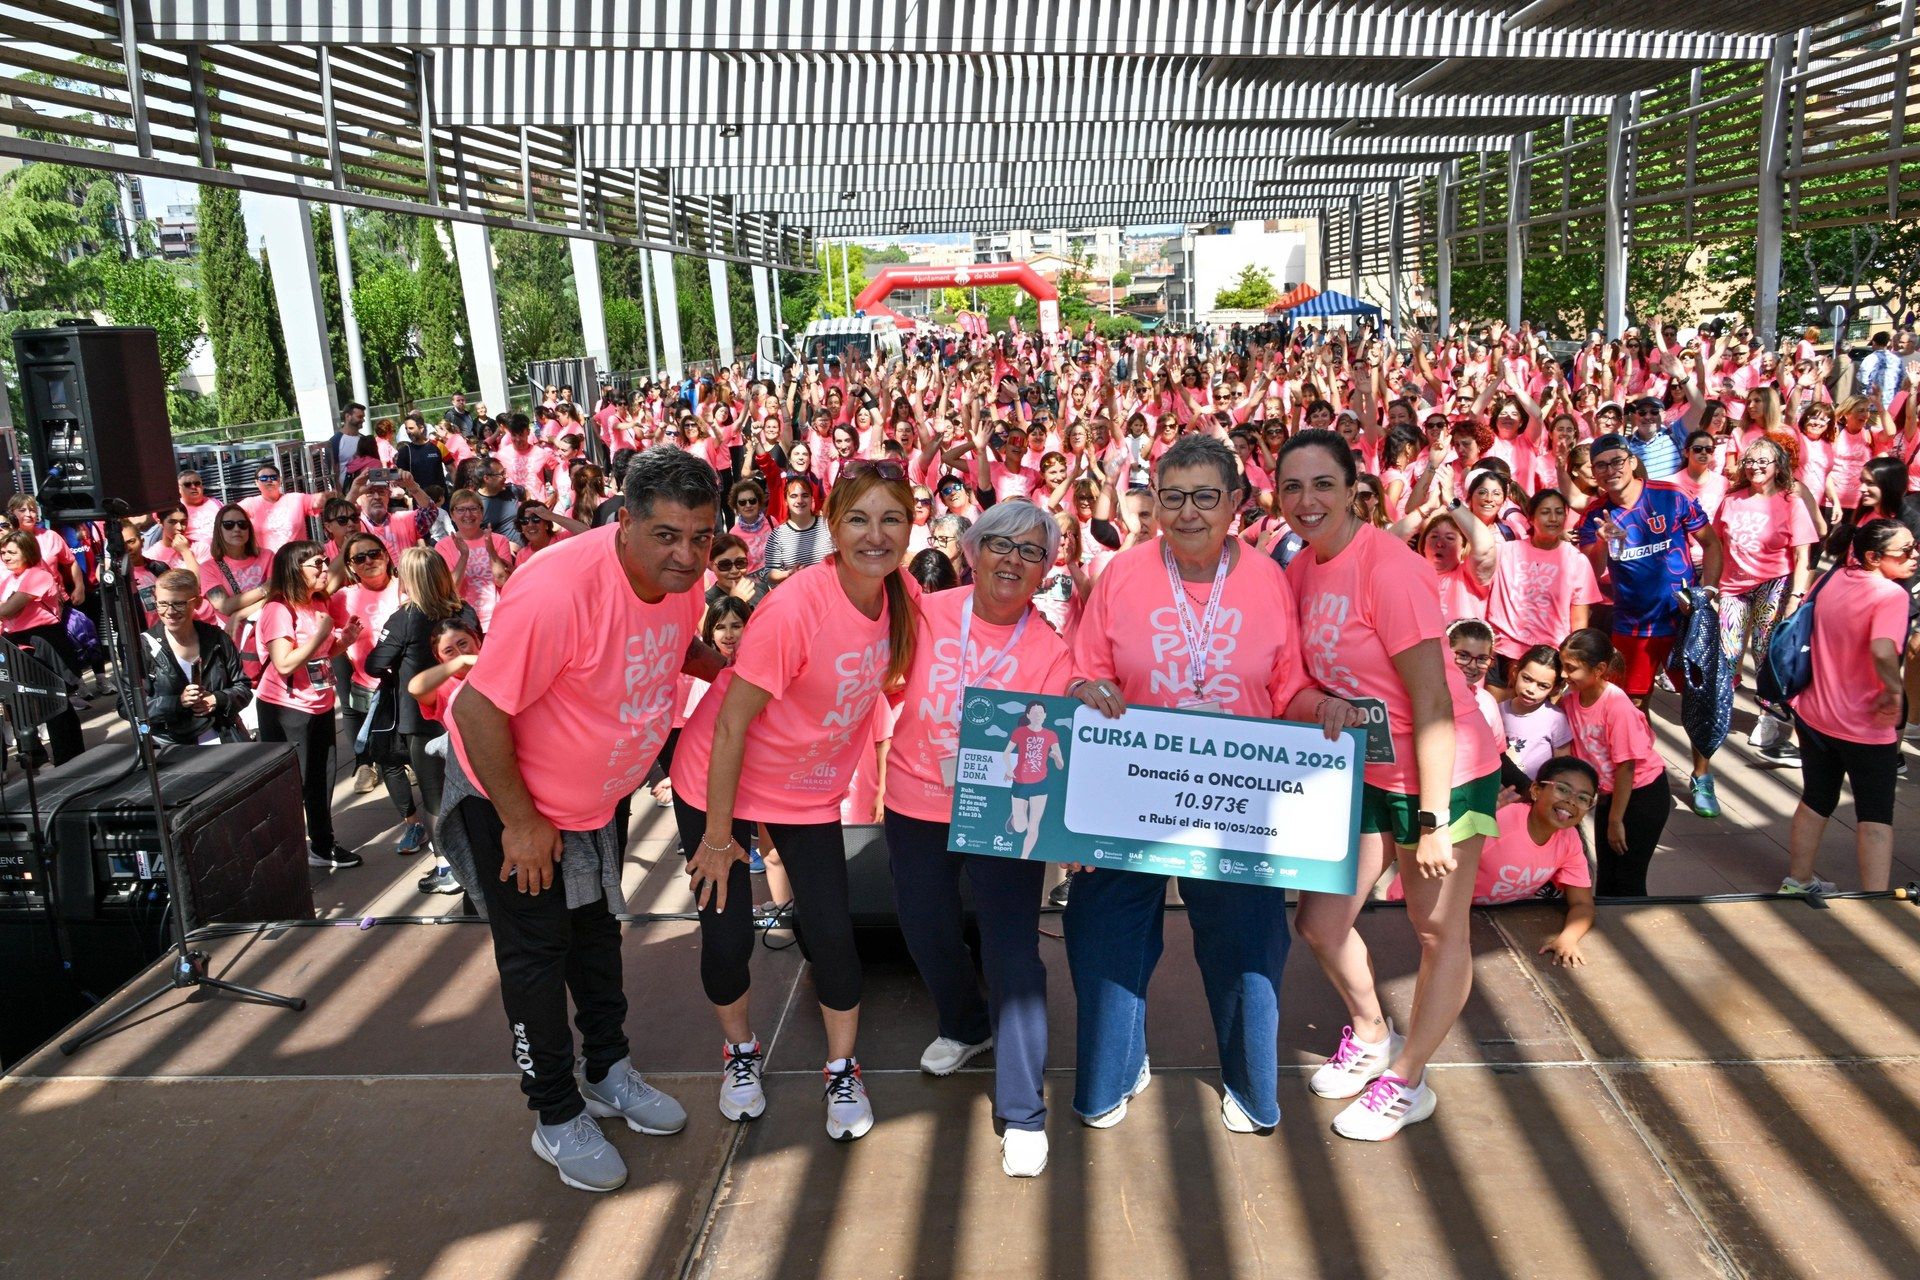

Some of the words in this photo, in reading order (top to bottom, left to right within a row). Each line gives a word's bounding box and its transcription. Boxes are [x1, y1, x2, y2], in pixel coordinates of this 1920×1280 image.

[913, 274, 950, 283] Ajuntament
[984, 272, 999, 280] Rubí
[1078, 725, 1147, 750] CURSA
[1154, 733, 1183, 753] DE
[1189, 737, 1218, 757] LA
[1223, 740, 1290, 765] DONA
[1296, 750, 1347, 771] 2026
[964, 753, 993, 763] CURSA
[962, 771, 987, 780] DONA
[963, 762, 975, 770] DE
[977, 763, 988, 772] LA
[1127, 763, 1190, 783] Donació
[1193, 774, 1204, 785] a
[1208, 771, 1305, 795] ONCOLLIGA
[1174, 791, 1249, 815] 10.973€
[1138, 813, 1147, 823] a
[1149, 813, 1177, 827] Rubí
[1179, 816, 1189, 828] el
[1192, 817, 1211, 830] dia
[1214, 820, 1278, 837] 10/05/2026
